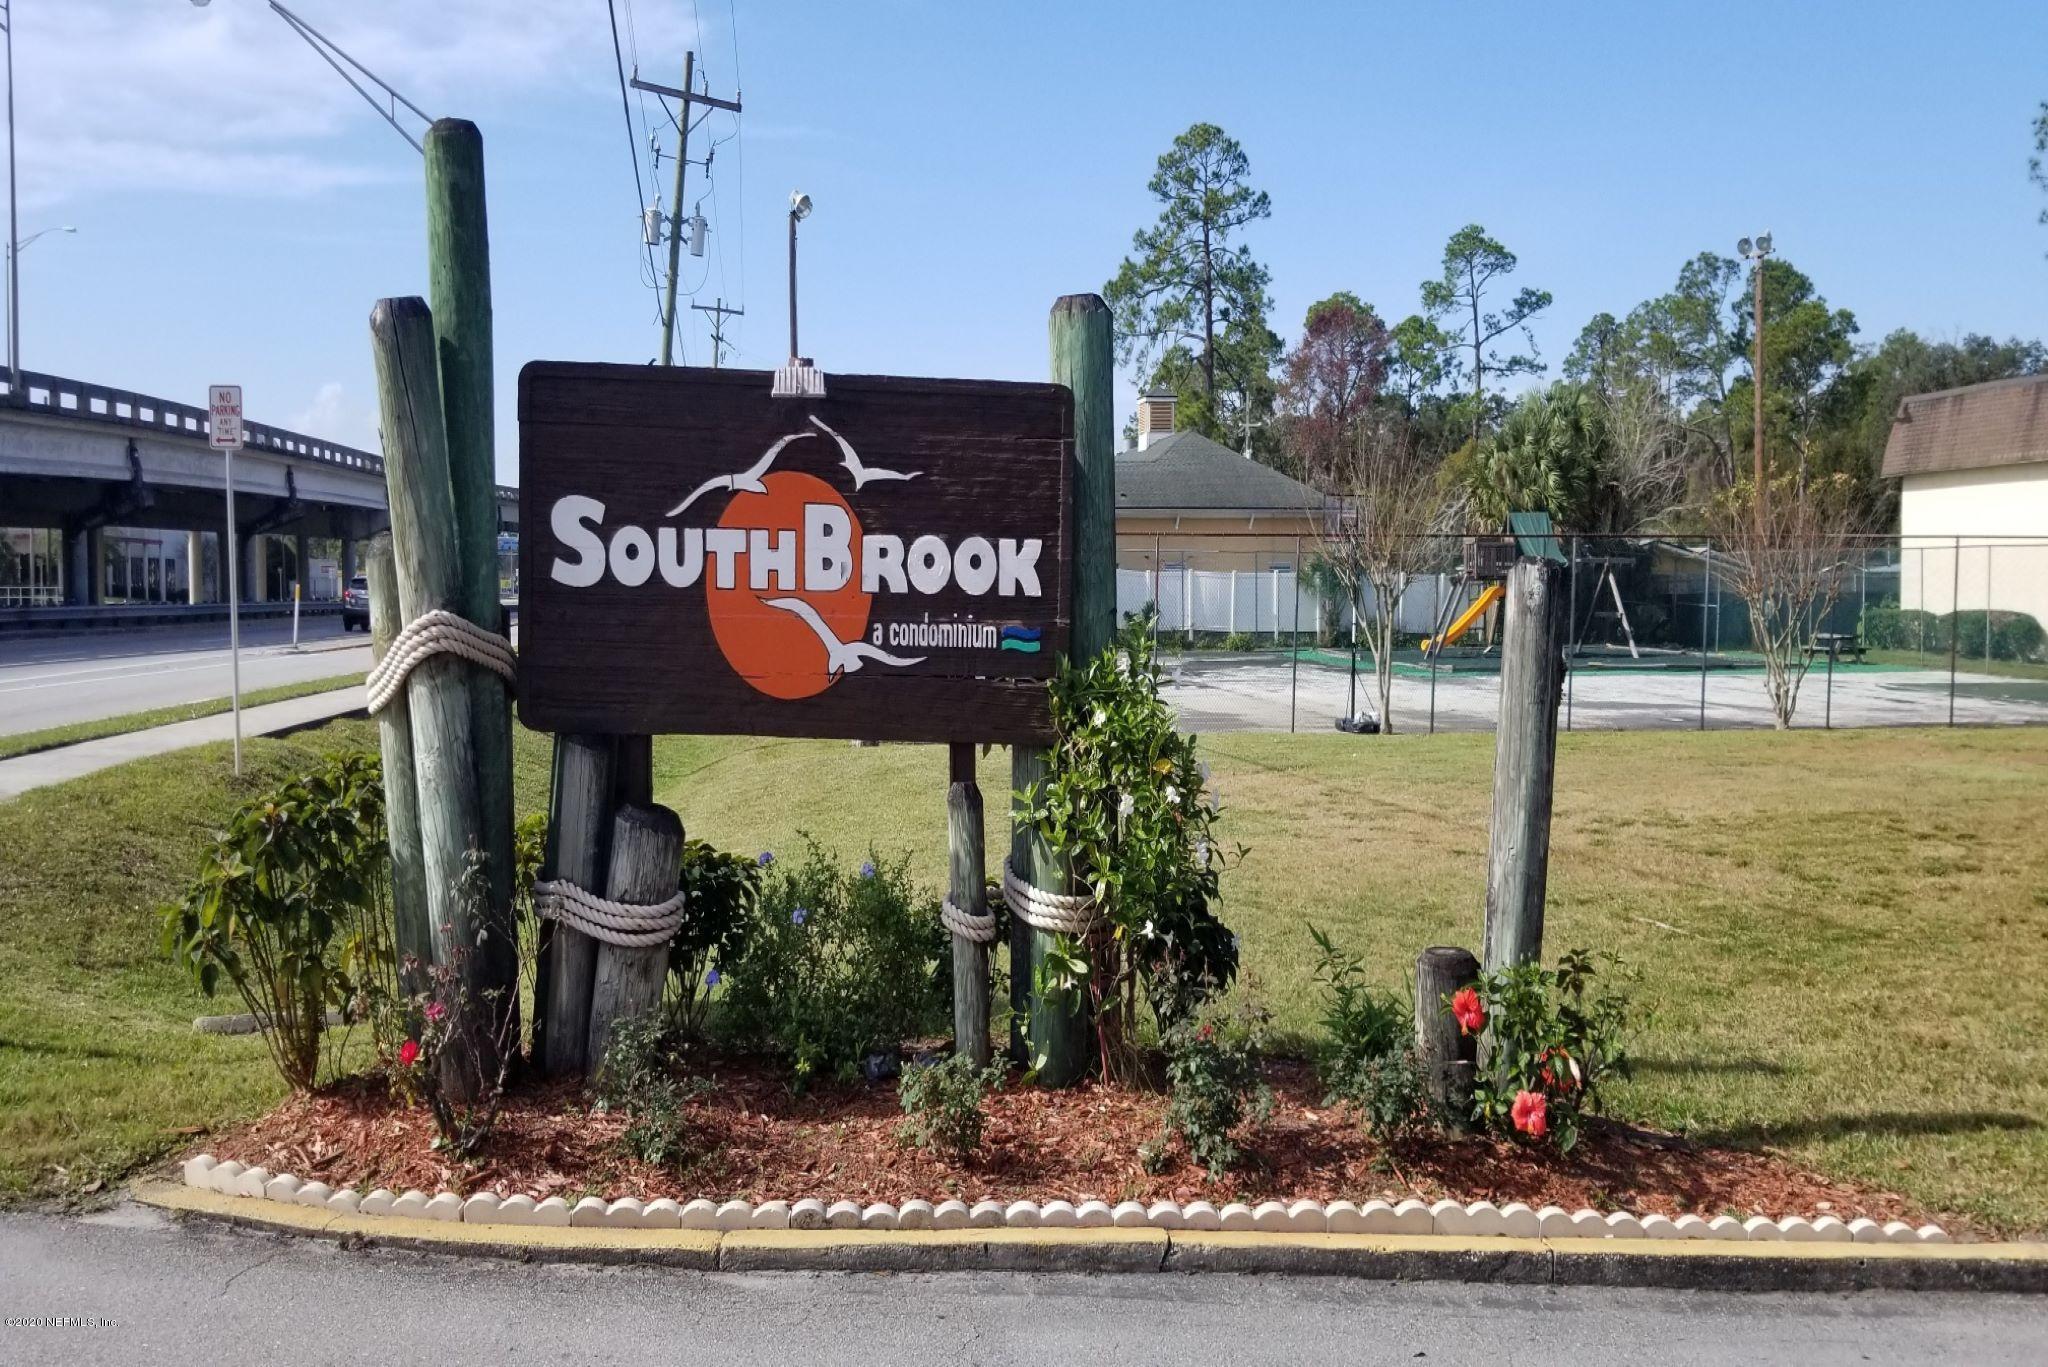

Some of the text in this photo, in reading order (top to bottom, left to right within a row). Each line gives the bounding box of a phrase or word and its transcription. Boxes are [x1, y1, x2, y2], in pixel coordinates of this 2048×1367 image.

[219, 392, 232, 403] NO
[211, 405, 241, 416] PARKING
[217, 427, 236, 435] TIME
[872, 611, 997, 648] a condominium
